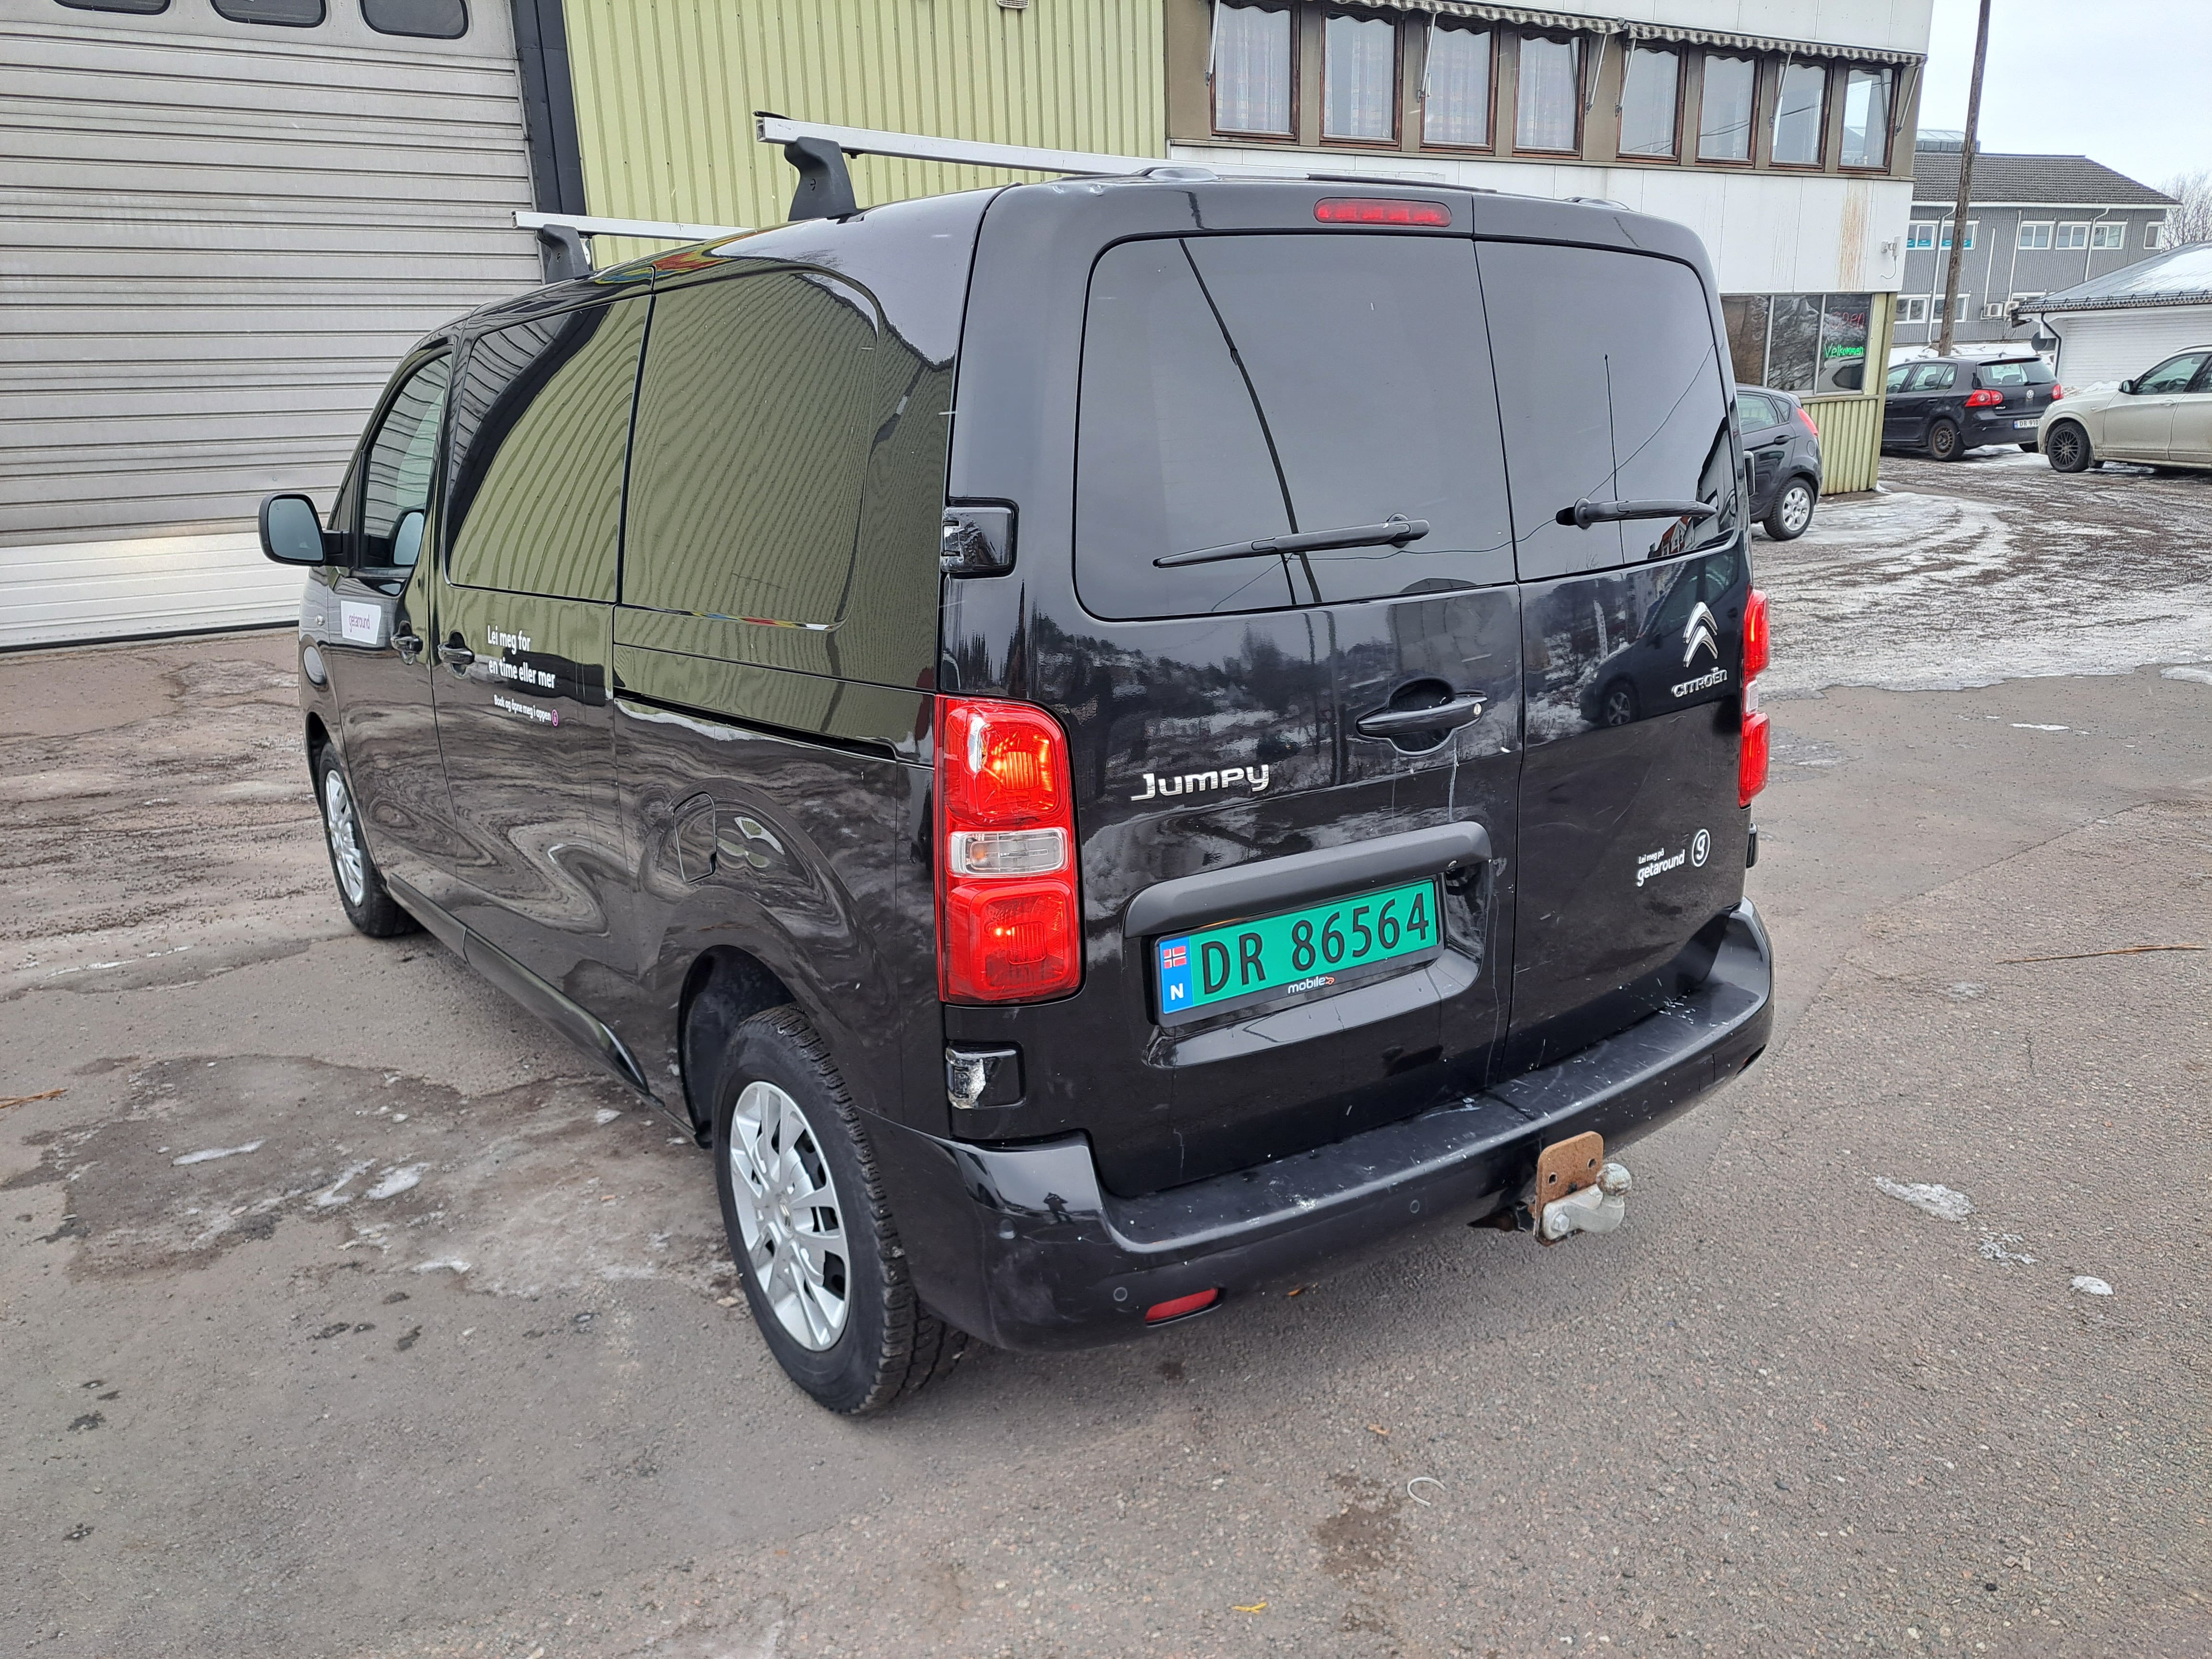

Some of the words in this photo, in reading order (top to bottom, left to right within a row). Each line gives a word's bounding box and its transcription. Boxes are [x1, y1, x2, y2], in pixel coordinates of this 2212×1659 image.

[1824, 343, 1864, 358] Velkommen
[348, 613, 370, 633] getaround
[487, 625, 498, 645] Lei
[499, 632, 517, 655] meg
[518, 630, 531, 652] for
[488, 660, 498, 675] en
[499, 656, 518, 679] time
[519, 662, 537, 684] eller
[538, 671, 555, 689] mer
[494, 694, 505, 708] Book
[505, 700, 511, 713] og
[523, 705, 533, 719] meg
[533, 705, 536, 717] i
[1638, 854, 1646, 864] Lei
[1647, 852, 1657, 862] meg
[1658, 847, 1665, 860] på
[1636, 849, 1685, 887] getaround
[1201, 932, 1266, 995] DR
[1291, 892, 1429, 972] 86564
[1170, 983, 1184, 1001] N
[1288, 976, 1326, 994] mobile
